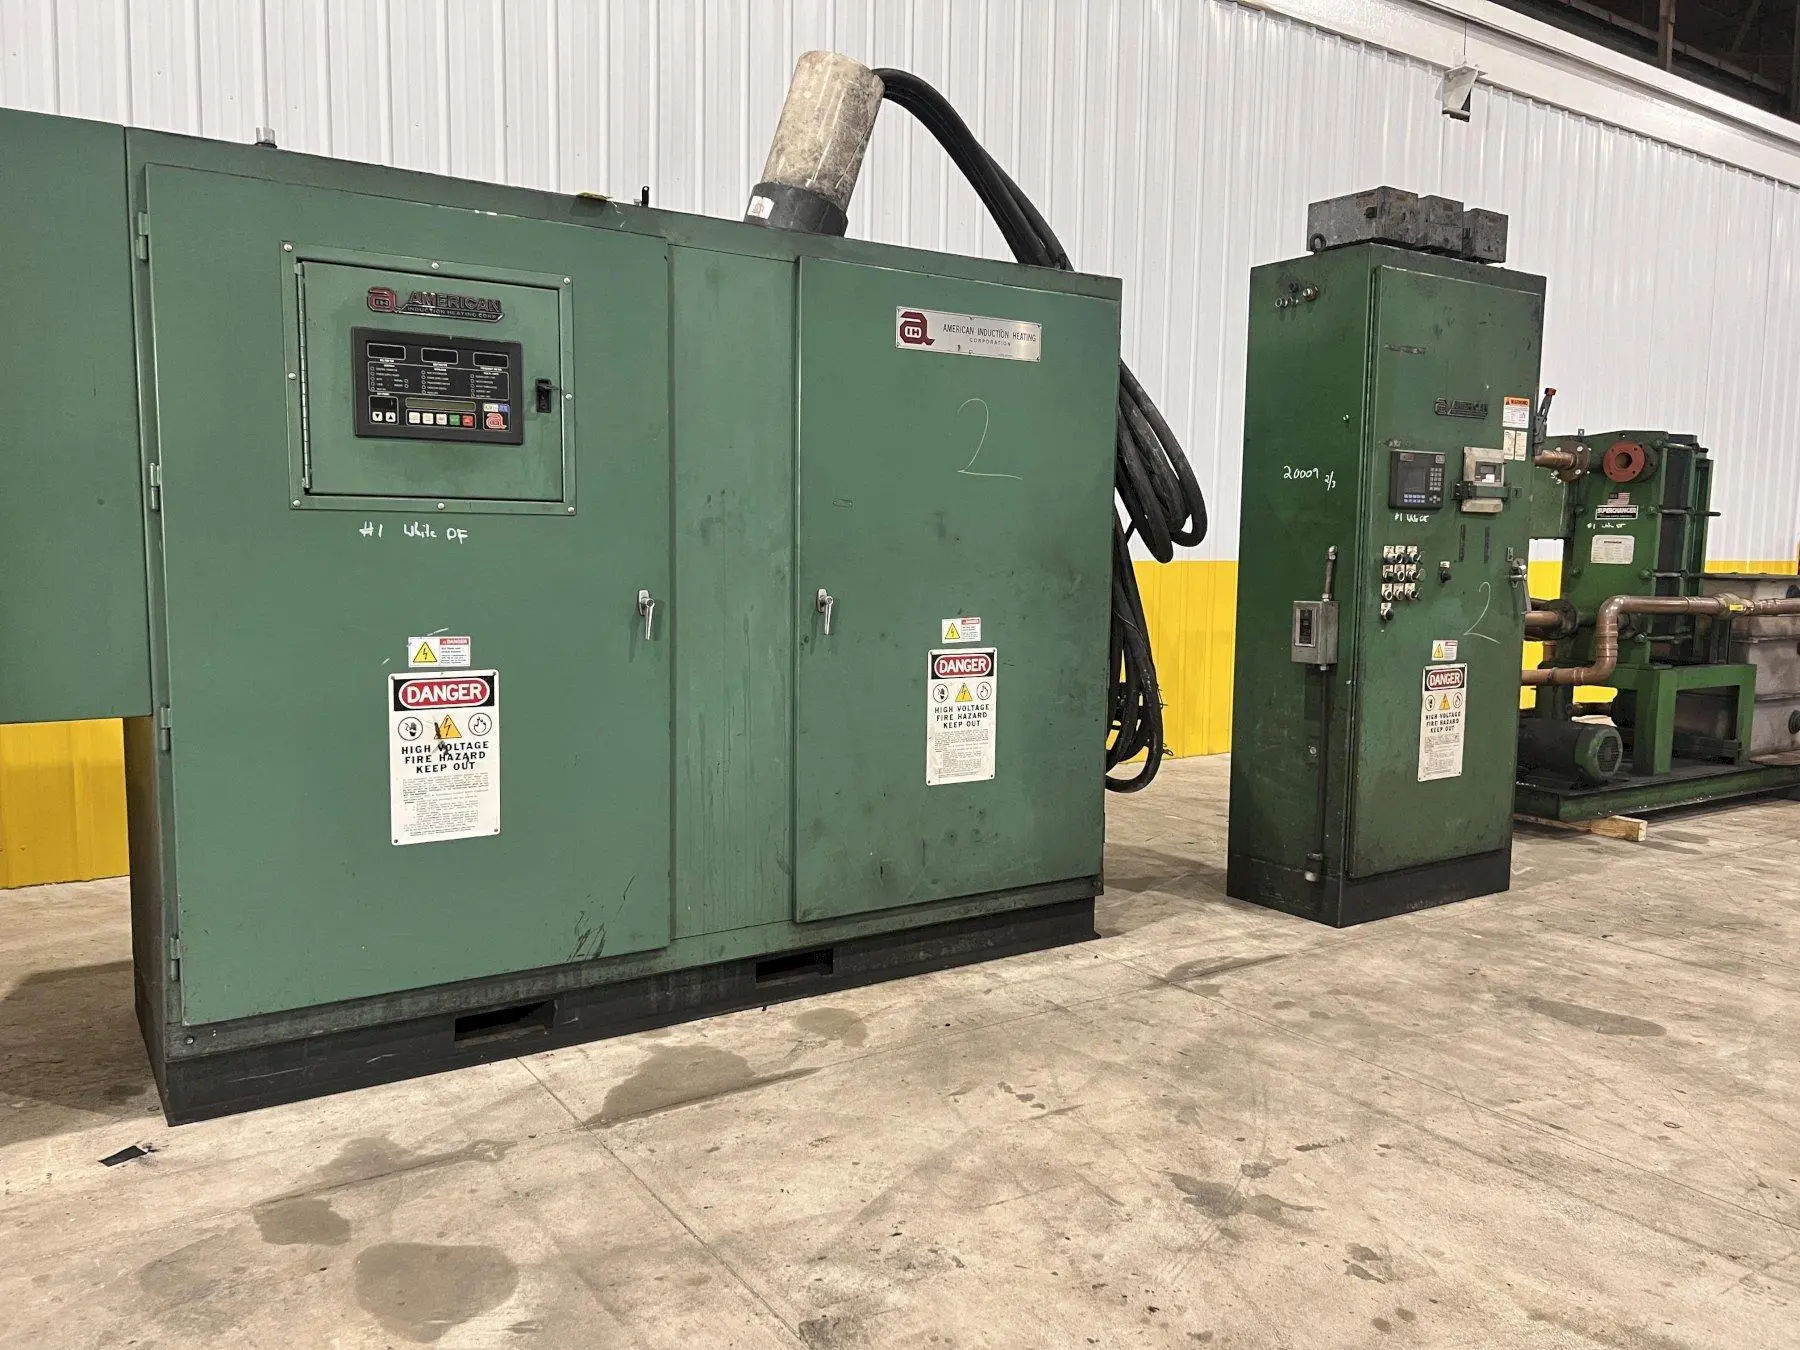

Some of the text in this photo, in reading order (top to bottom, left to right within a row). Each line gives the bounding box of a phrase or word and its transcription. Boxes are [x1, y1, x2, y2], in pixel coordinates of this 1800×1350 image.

[408, 290, 502, 313] AMERICAN
[407, 305, 446, 315] INDUCTION
[446, 309, 478, 318] HEATING
[942, 323, 1037, 342] AMERICAN INDUCTION HEATING
[969, 337, 1012, 347] CORPORATION
[956, 397, 1023, 481] 2
[1283, 465, 1319, 480] 20009
[358, 520, 384, 538] #1
[939, 657, 987, 675] DANGER
[1429, 673, 1461, 688] DANGER
[406, 683, 483, 705] DANGER
[934, 703, 990, 715] HIGH VOLTAGE
[1425, 711, 1461, 721] HIGH VOLTAGE
[936, 712, 988, 722] FIRE HAZARD
[943, 719, 981, 729] KEEP OUT
[401, 740, 489, 755] HIGH VOLTAGE
[404, 750, 486, 765] FIRE HAZARD
[416, 760, 476, 774] KEEP OUT
